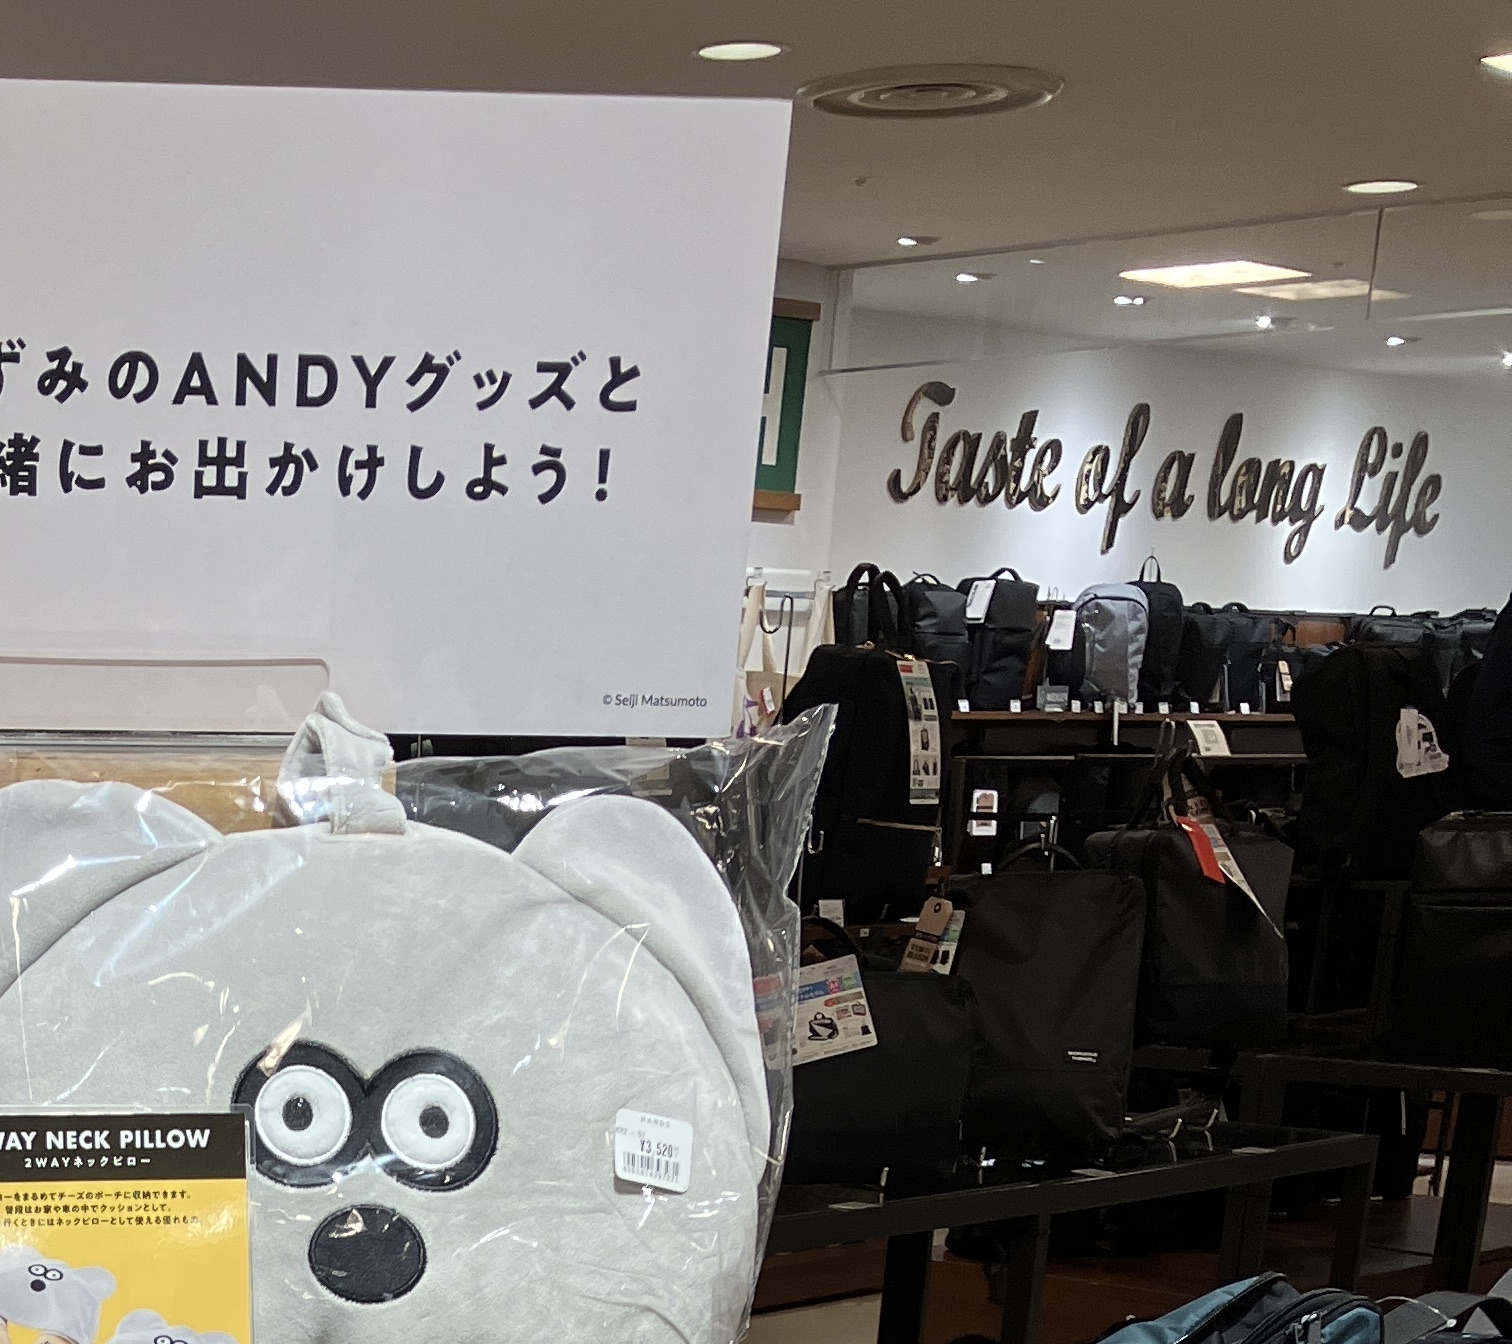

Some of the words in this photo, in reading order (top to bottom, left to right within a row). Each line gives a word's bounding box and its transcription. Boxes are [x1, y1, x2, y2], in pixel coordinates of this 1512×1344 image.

[887, 381, 1063, 511] Taste
[1075, 403, 1151, 554] of
[1152, 449, 1194, 521] a
[1207, 413, 1326, 565] long
[1334, 426, 1442, 570] Life
[615, 694, 638, 708] Seiji
[641, 694, 707, 707] Matsumoto
[46, 1131, 110, 1149] NECK
[120, 1129, 211, 1149] PILLOW
[25, 1156, 151, 1168] 2WAYネックピロー
